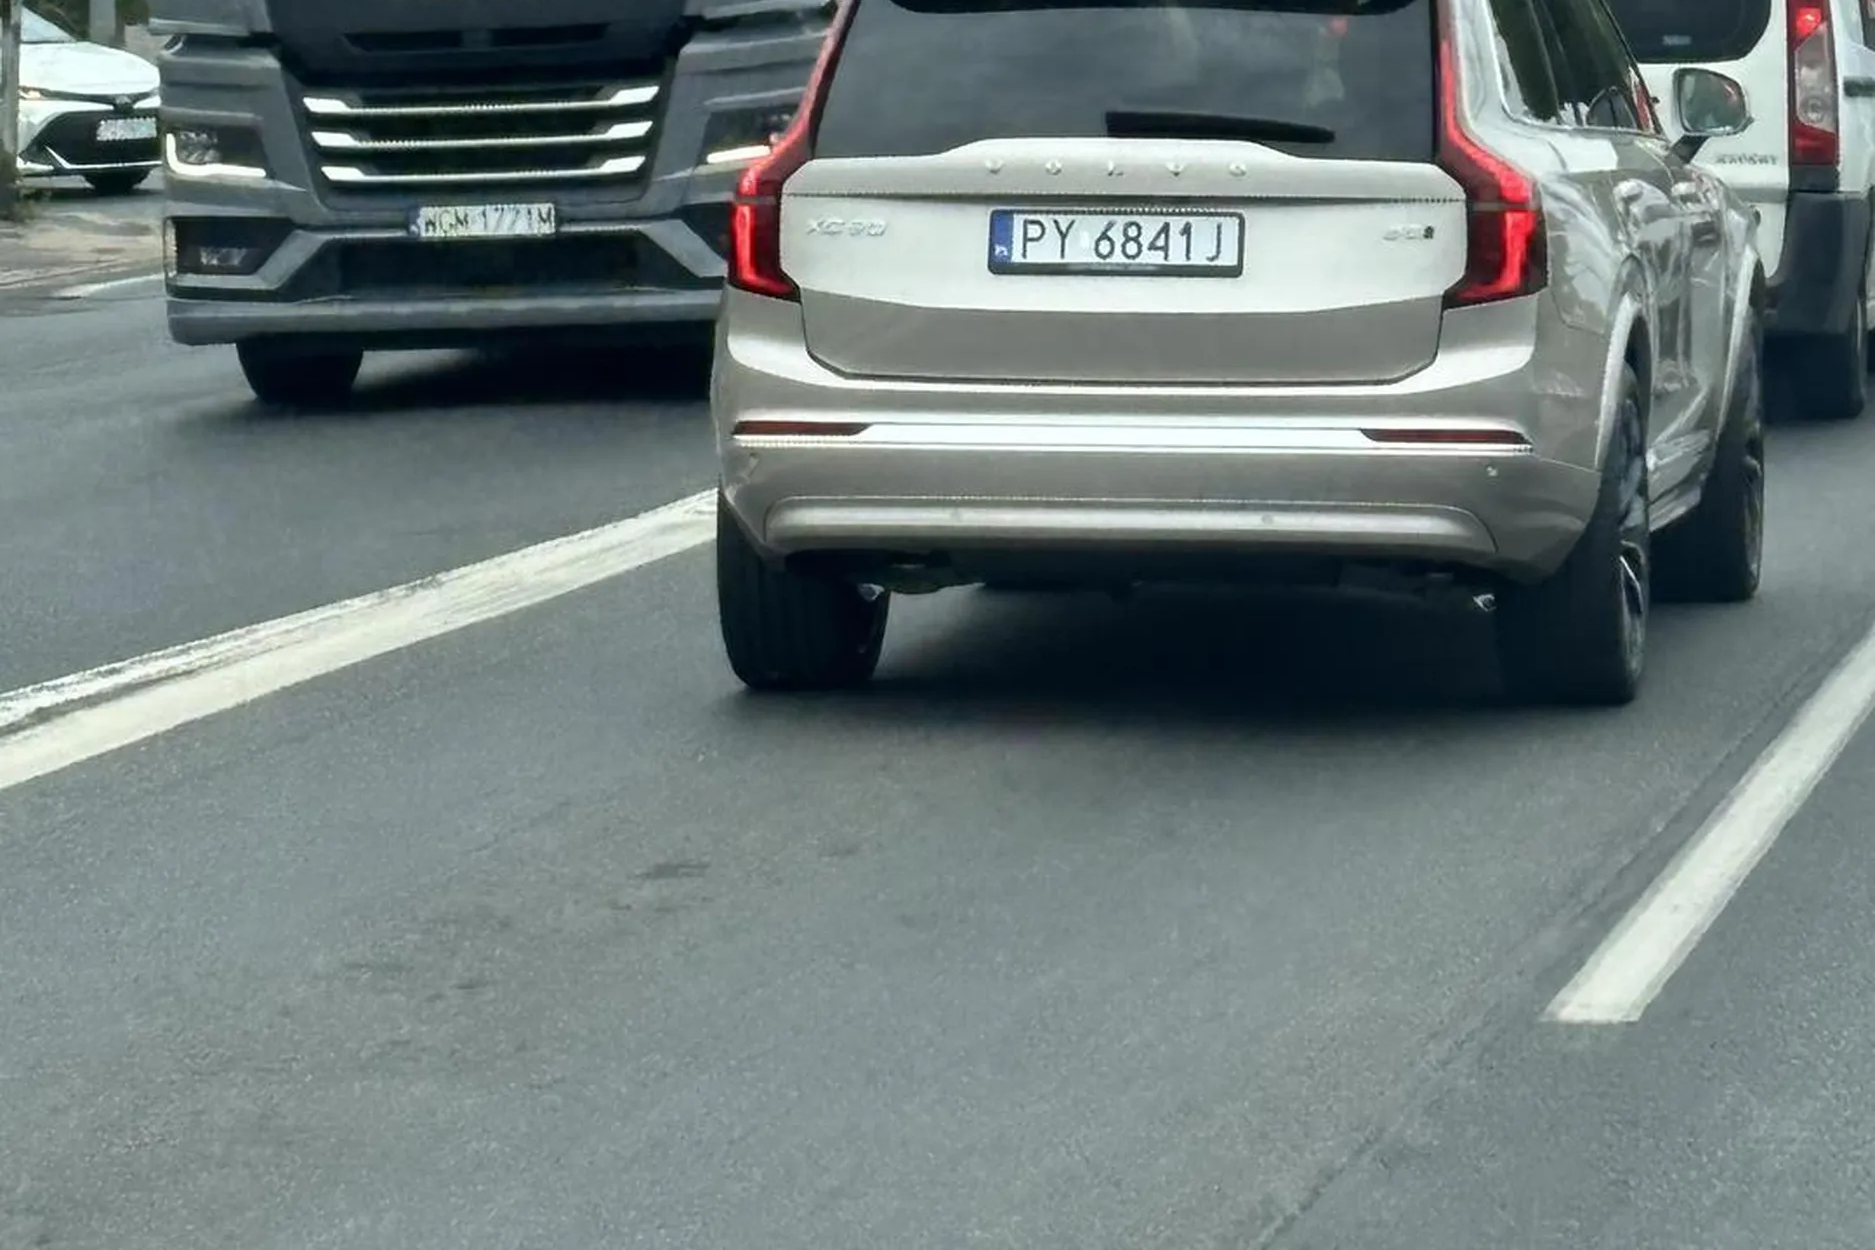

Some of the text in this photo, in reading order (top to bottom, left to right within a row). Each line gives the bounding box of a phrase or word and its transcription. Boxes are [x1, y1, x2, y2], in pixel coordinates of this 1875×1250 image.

[984, 159, 1247, 177] VOLVO
[1021, 218, 1222, 262] PY 6841J
